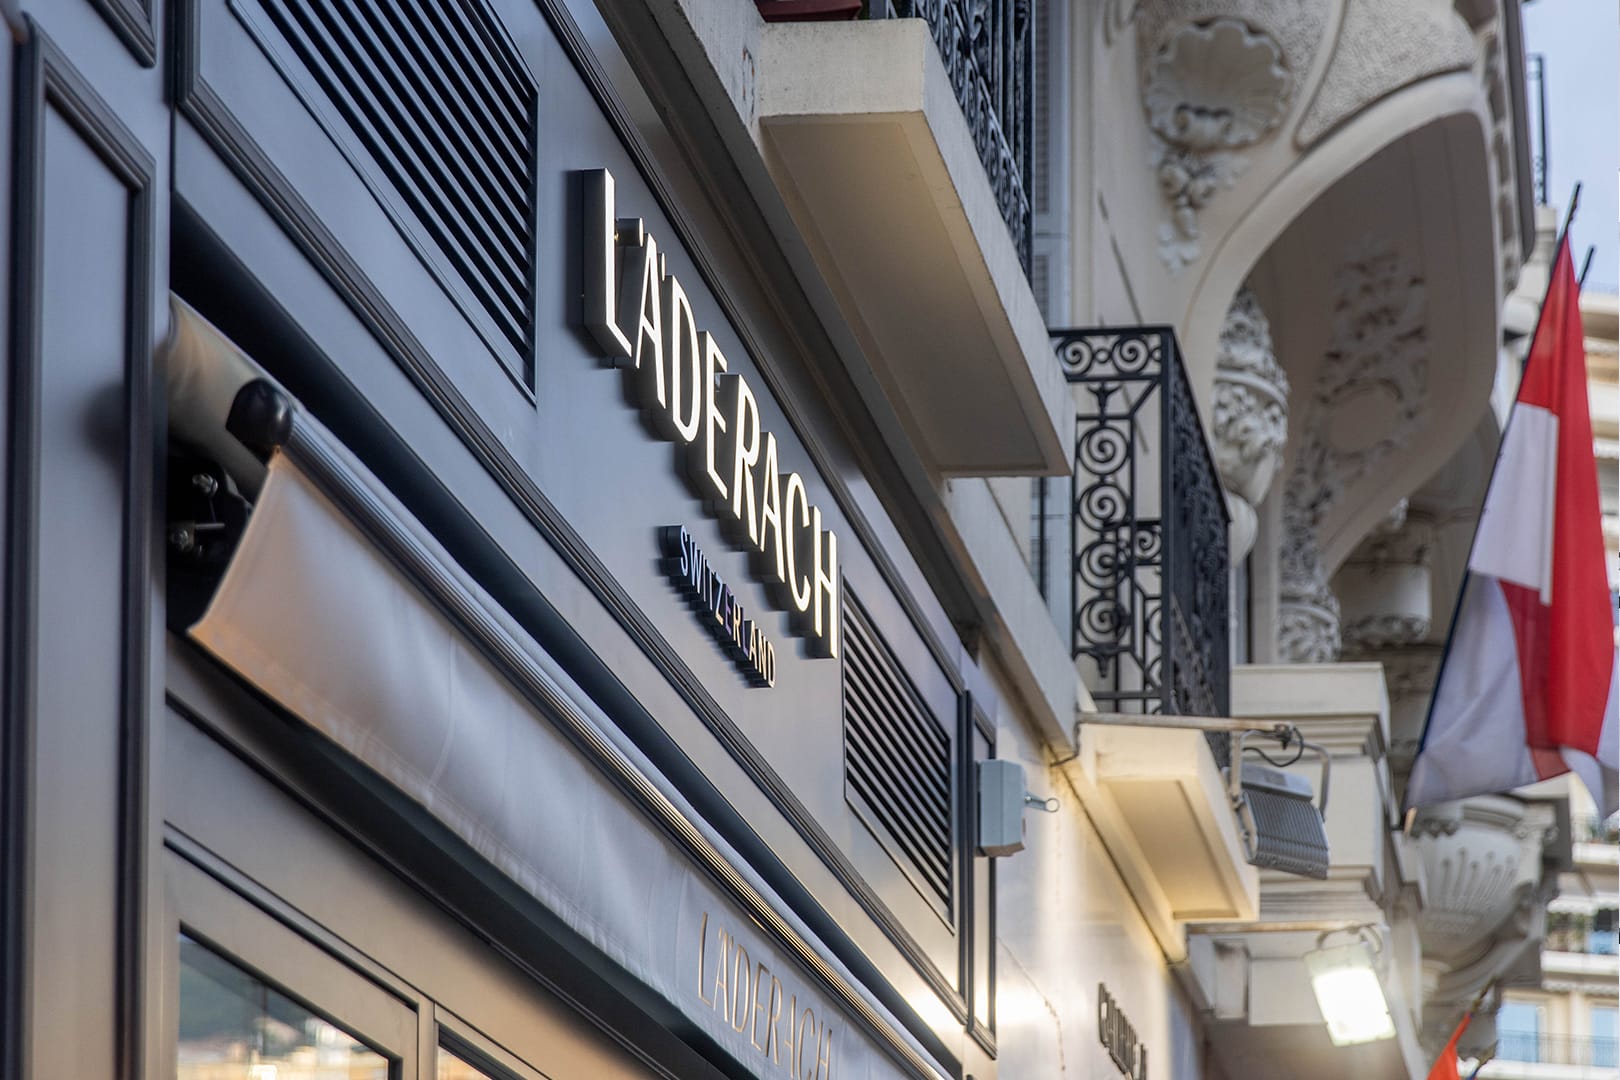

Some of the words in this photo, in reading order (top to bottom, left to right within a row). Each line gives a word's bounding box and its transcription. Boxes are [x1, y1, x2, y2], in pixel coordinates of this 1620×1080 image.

[603, 168, 837, 658] LÄDERACH
[680, 525, 776, 688] SWITZERLAND
[698, 912, 832, 1080] LÄDERACH
